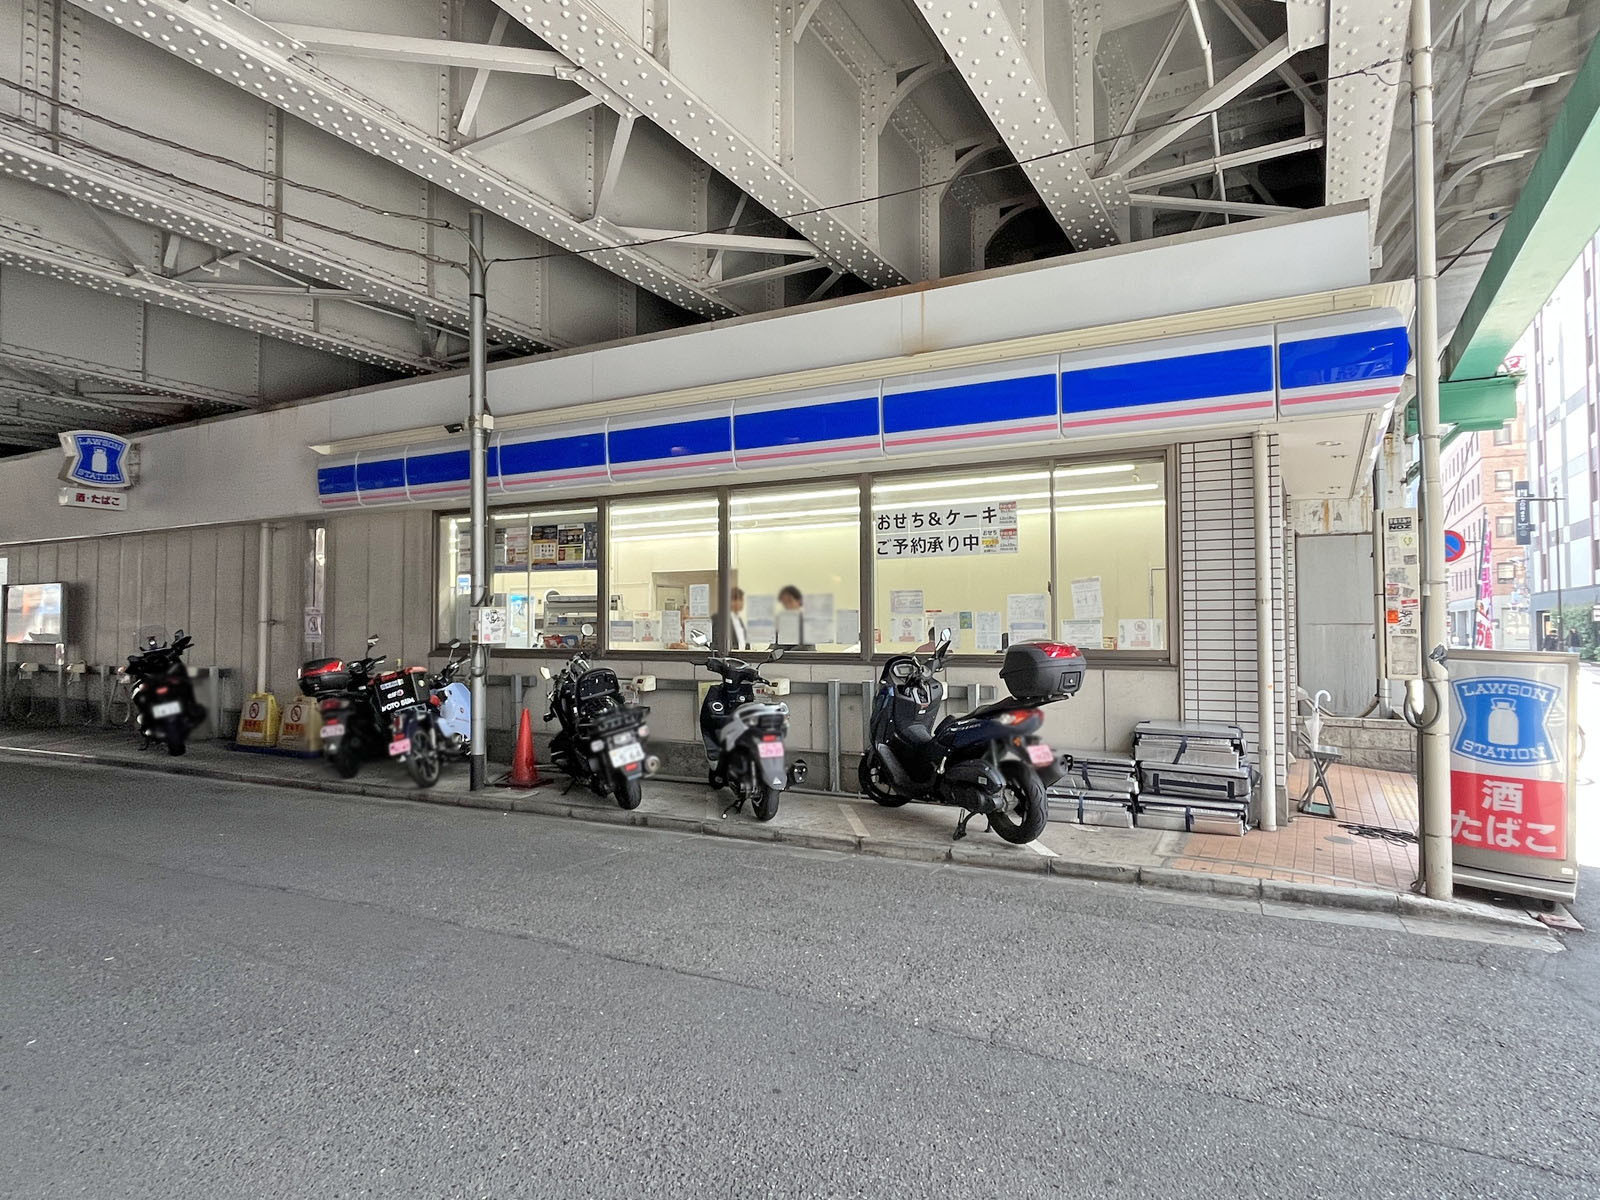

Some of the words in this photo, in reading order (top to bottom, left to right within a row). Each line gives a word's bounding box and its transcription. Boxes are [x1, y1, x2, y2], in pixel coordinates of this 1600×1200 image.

[79, 437, 122, 451] LAWSON
[78, 469, 120, 481] STATION
[877, 506, 997, 531] おせち&ケーキ
[877, 534, 979, 555] ご予約承り中
[1462, 683, 1550, 702] LAWSON
[1462, 740, 1547, 760] STATION
[1481, 779, 1524, 814] 酒
[1451, 809, 1557, 853] たばこ
